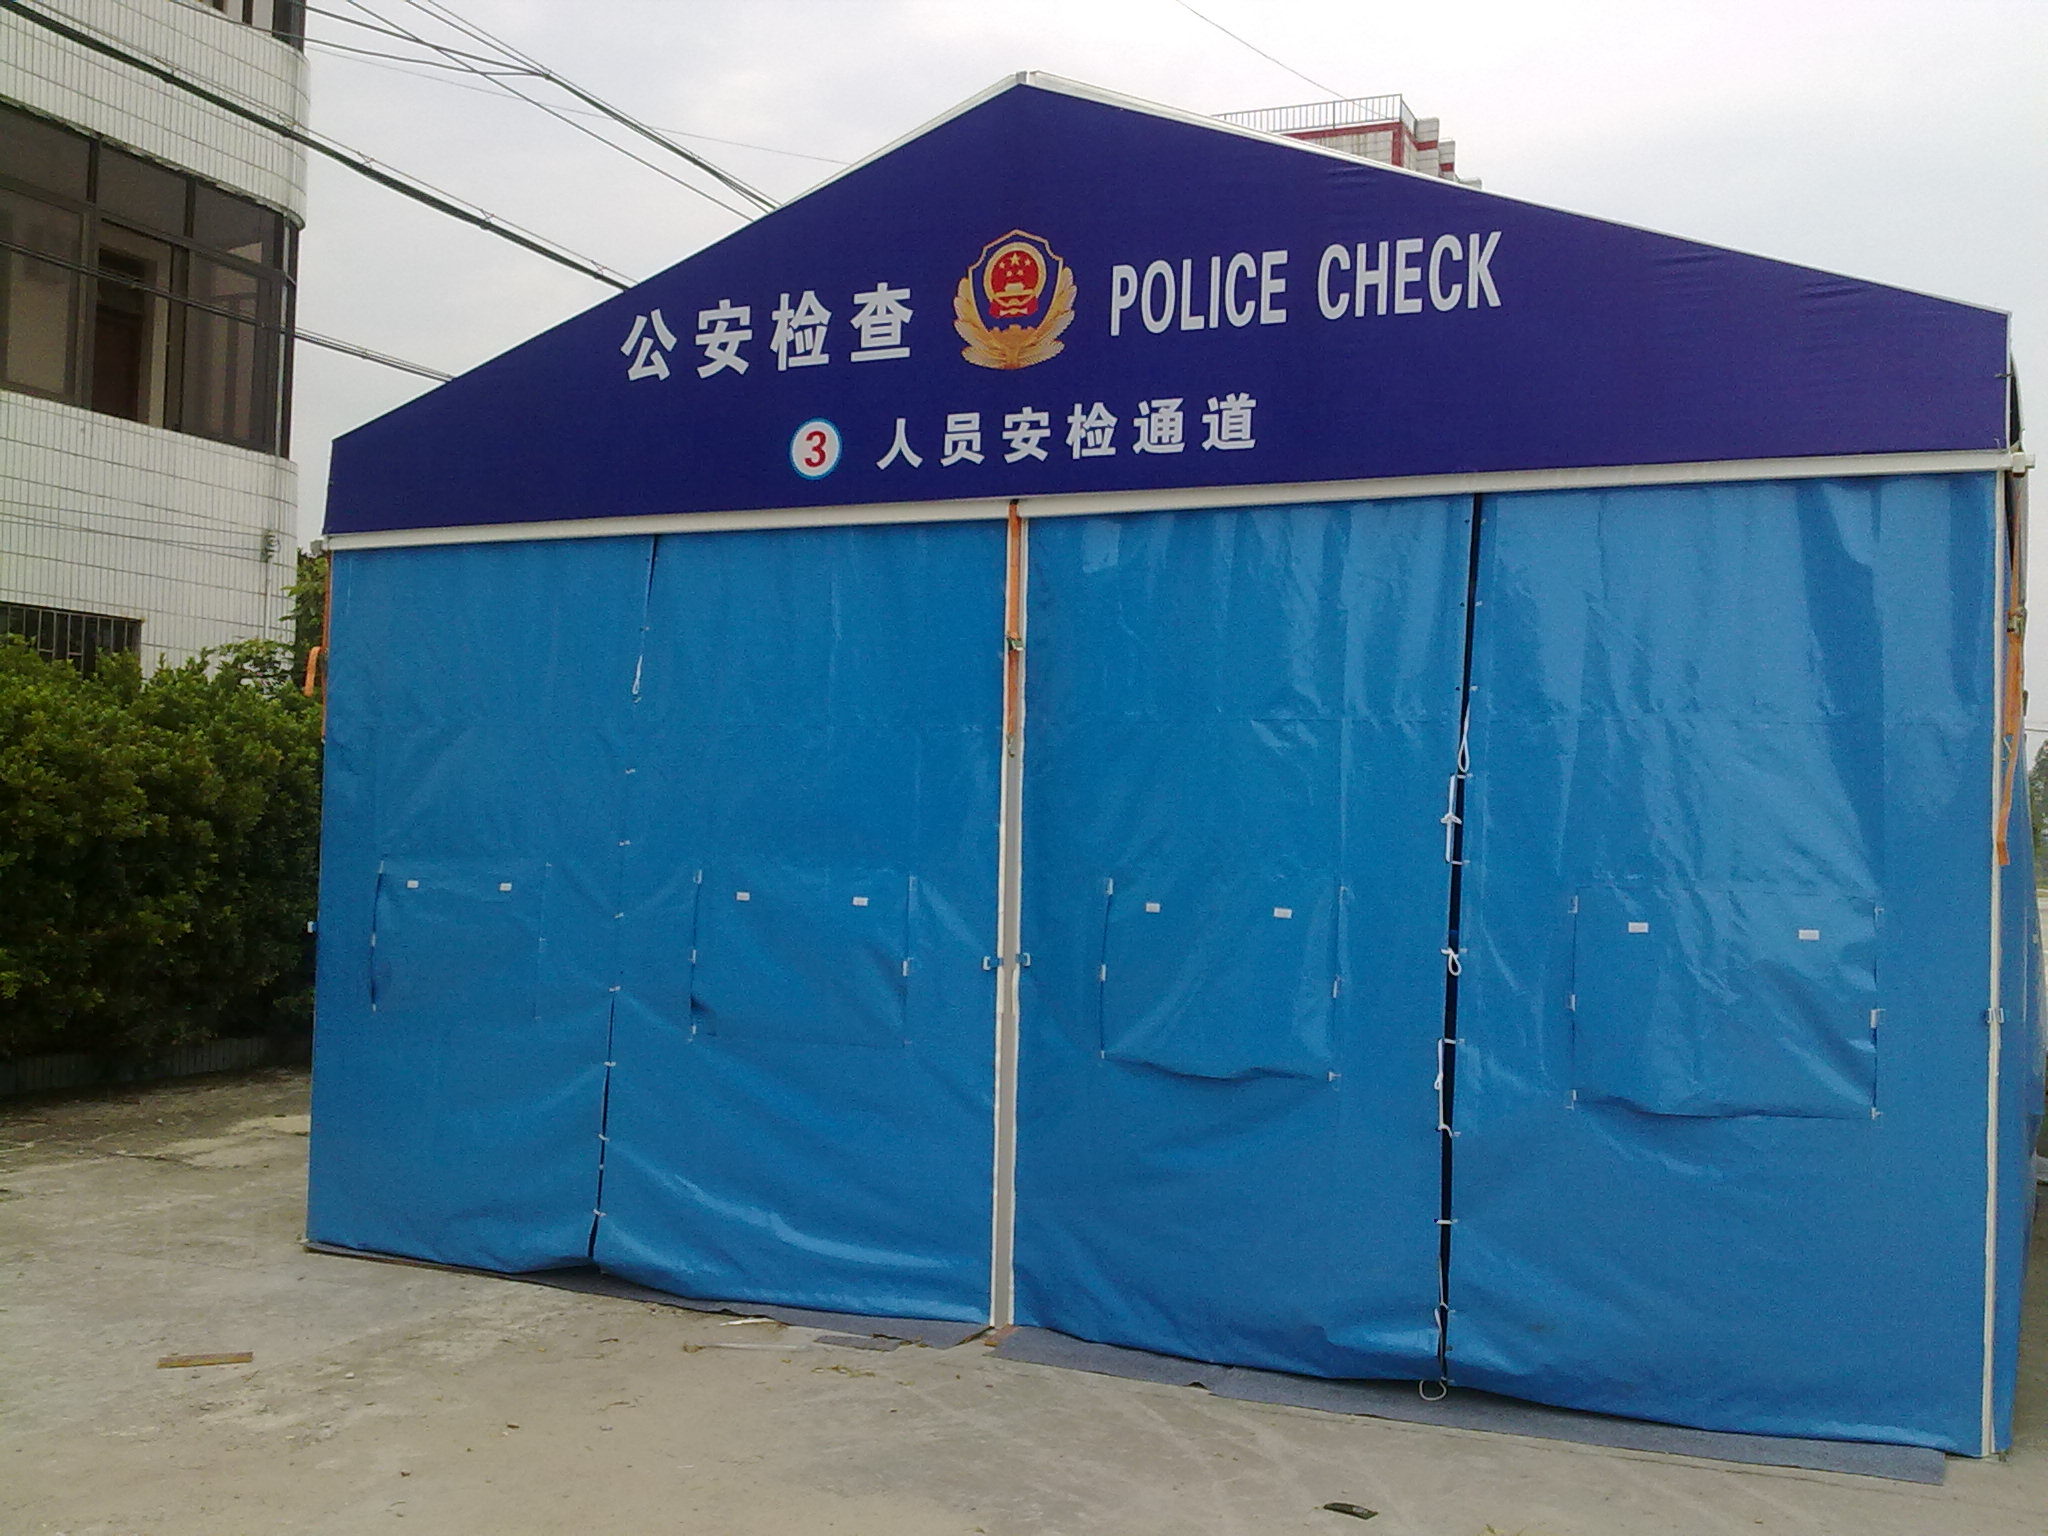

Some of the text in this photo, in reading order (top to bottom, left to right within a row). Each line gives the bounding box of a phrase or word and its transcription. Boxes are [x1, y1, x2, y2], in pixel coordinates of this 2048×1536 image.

[1110, 231, 1503, 337] POLICE CHECK
[620, 282, 914, 382] 公安检查
[804, 430, 828, 468] 3
[876, 392, 1257, 471] 人员安检通道
